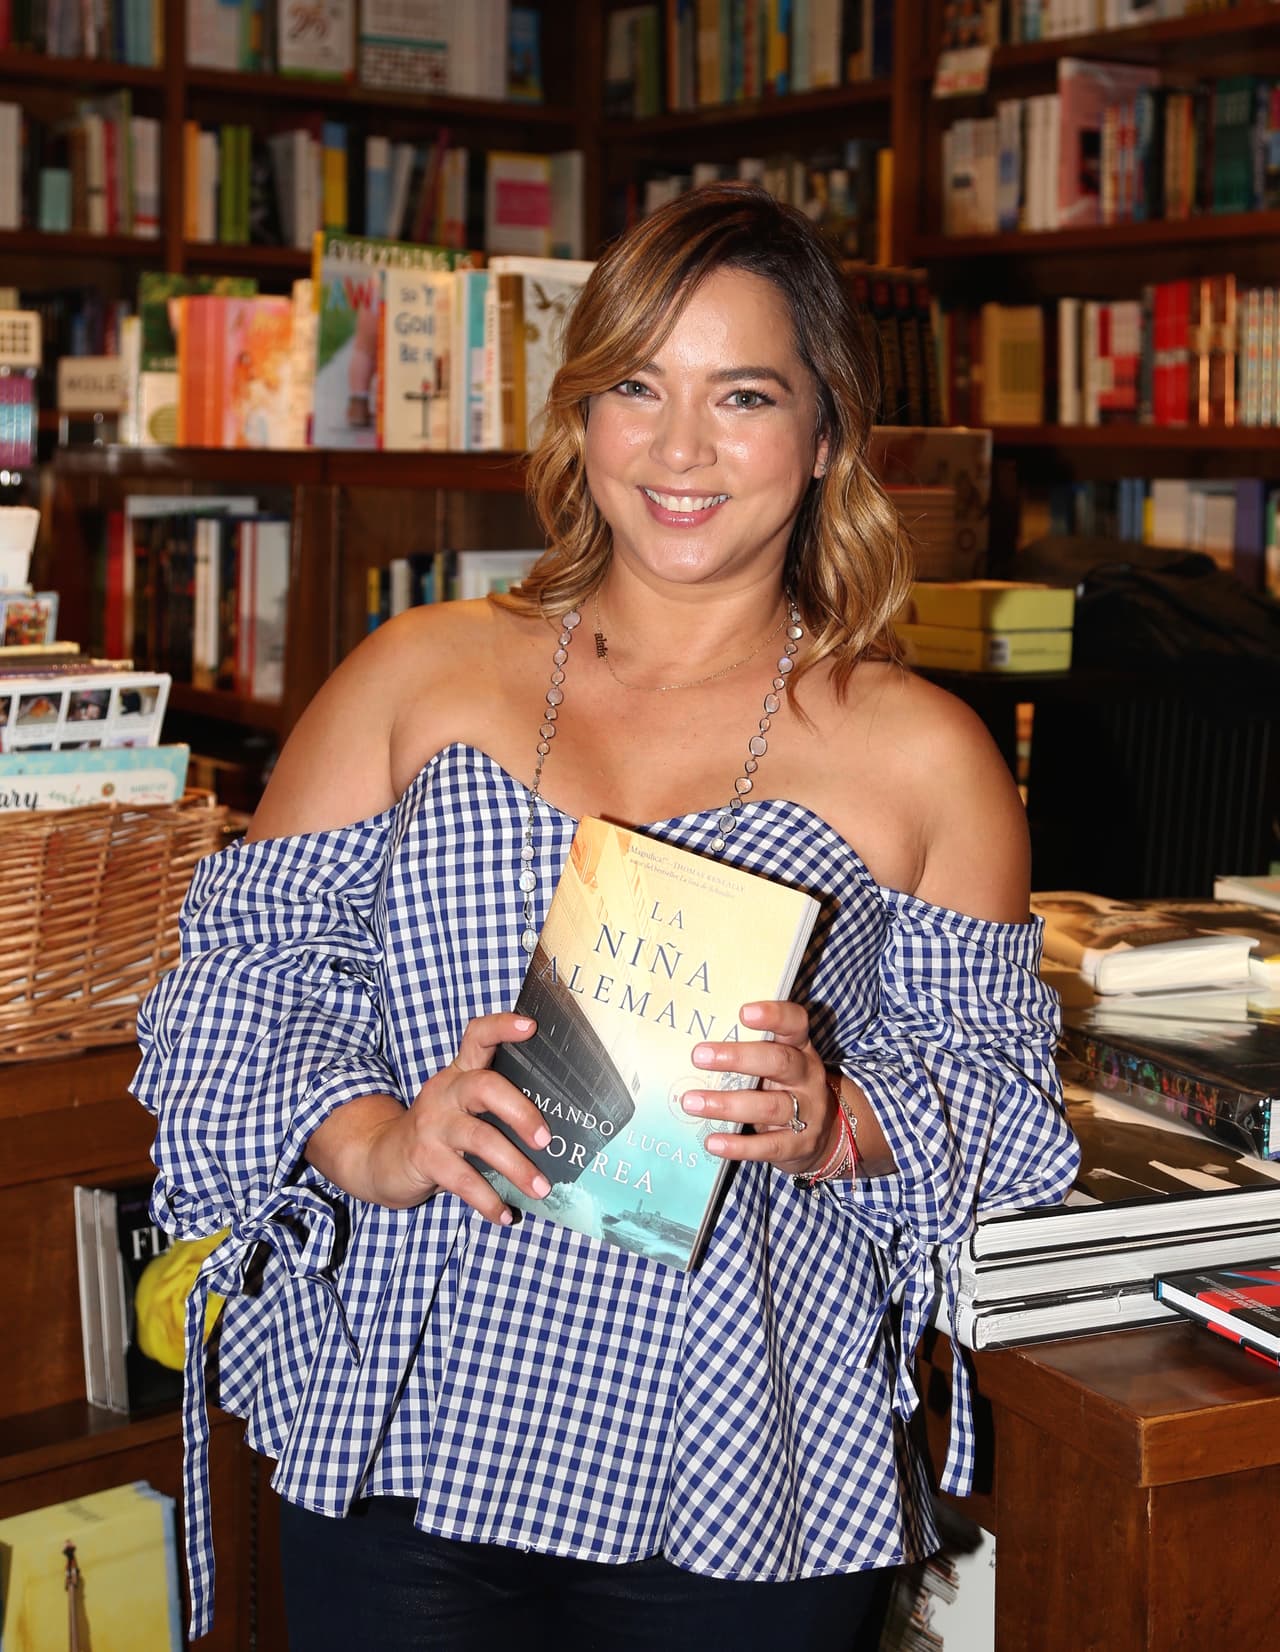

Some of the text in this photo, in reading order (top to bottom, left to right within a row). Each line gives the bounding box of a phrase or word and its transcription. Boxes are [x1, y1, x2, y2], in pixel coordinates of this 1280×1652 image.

[326, 275, 378, 315] AW
[650, 901, 685, 930] LA
[593, 923, 711, 993] NIÑA
[538, 955, 740, 1043] ALEMANA
[522, 1088, 699, 1168] RMANDO LUCAS
[546, 1135, 654, 1194] ORREA
